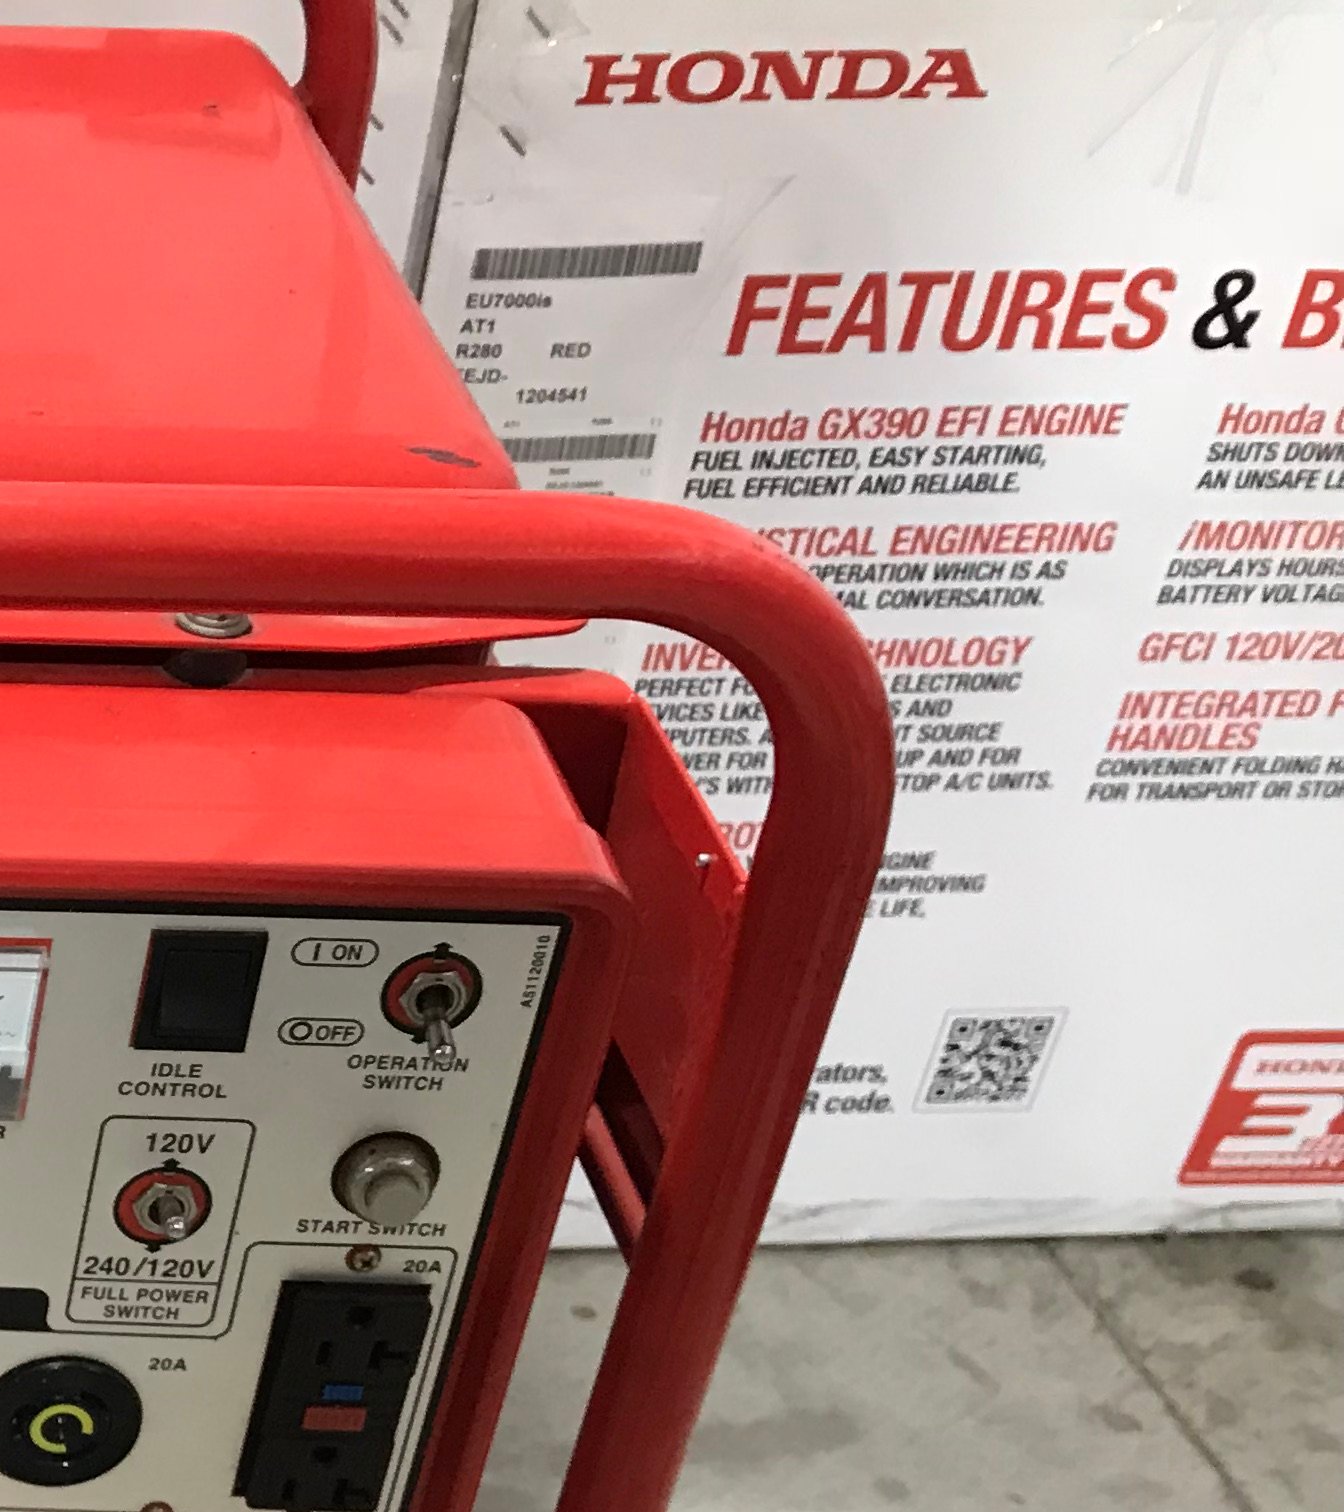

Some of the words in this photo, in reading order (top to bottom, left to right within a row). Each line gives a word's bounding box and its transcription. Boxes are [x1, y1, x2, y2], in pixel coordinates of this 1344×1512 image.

[574, 48, 988, 106] HONDA
[465, 292, 552, 309] EU7000is
[725, 266, 1177, 356] FEATURES
[1191, 269, 1261, 351] &
[460, 318, 496, 334] AT1
[455, 343, 503, 359] R280
[550, 342, 592, 358] RED
[458, 368, 509, 384] EJD-
[516, 386, 588, 404] 1204541
[700, 410, 808, 443] Honda
[817, 407, 930, 441] GX390
[936, 405, 993, 438] EFI
[996, 403, 1129, 437] ENGINE
[1217, 402, 1326, 435] Honda
[691, 449, 743, 471] FUEL
[751, 447, 861, 472] INJECTED,
[869, 446, 928, 467] EASY
[932, 444, 1047, 469] STARTING,
[1207, 441, 1280, 462] SHUTS
[684, 477, 735, 500] FUEL
[742, 475, 854, 498] EFFICIENT
[858, 474, 906, 495] AND
[912, 472, 1020, 494] RELIABLE.
[1196, 469, 1231, 489] AN
[1234, 469, 1321, 489] UNSAFE
[889, 521, 1117, 556] ENGINEERING
[933, 560, 1006, 582] WHICH
[1011, 560, 1030, 580] IS
[1036, 559, 1068, 580] AS
[1165, 558, 1273, 578] DISPLAYS
[876, 586, 1044, 611] CONVERSATION.
[1157, 583, 1256, 605] BATTERY
[1262, 583, 1344, 604] VOLTAG
[871, 636, 1034, 668] HNOLOGY
[1138, 631, 1219, 662] GFCI
[635, 677, 726, 697] PERFECT
[891, 672, 1022, 693] ELECTRONIC
[655, 703, 715, 722] VICES
[905, 699, 953, 718] AND
[1118, 688, 1322, 719] INTEGRATED
[916, 721, 1003, 744] SOURCE
[1106, 722, 1261, 752] HANDLES
[726, 752, 768, 770] FOR
[927, 747, 973, 767] AND
[978, 746, 1022, 766] FOR
[1096, 756, 1229, 777] CONVENIENT
[1231, 755, 1323, 776] FOLDING
[1086, 781, 1129, 803] FOR
[1136, 780, 1259, 801] TRANSPORT
[1262, 780, 1292, 800] OR
[332, 944, 363, 961] ON
[315, 1024, 356, 1042] OFF
[150, 1063, 203, 1079] IDLE
[118, 1081, 227, 1099] CONTROL
[362, 1074, 444, 1092] SWITCH
[145, 1133, 216, 1154] 120V
[296, 1219, 362, 1236] START
[368, 1222, 447, 1238] SWITCH
[82, 1256, 216, 1278] 240/120V
[402, 1259, 443, 1275] 20A
[81, 1286, 130, 1302] FULL
[136, 1288, 209, 1304] POWER
[103, 1305, 180, 1321] SWITCH
[149, 1358, 187, 1371] 20A
